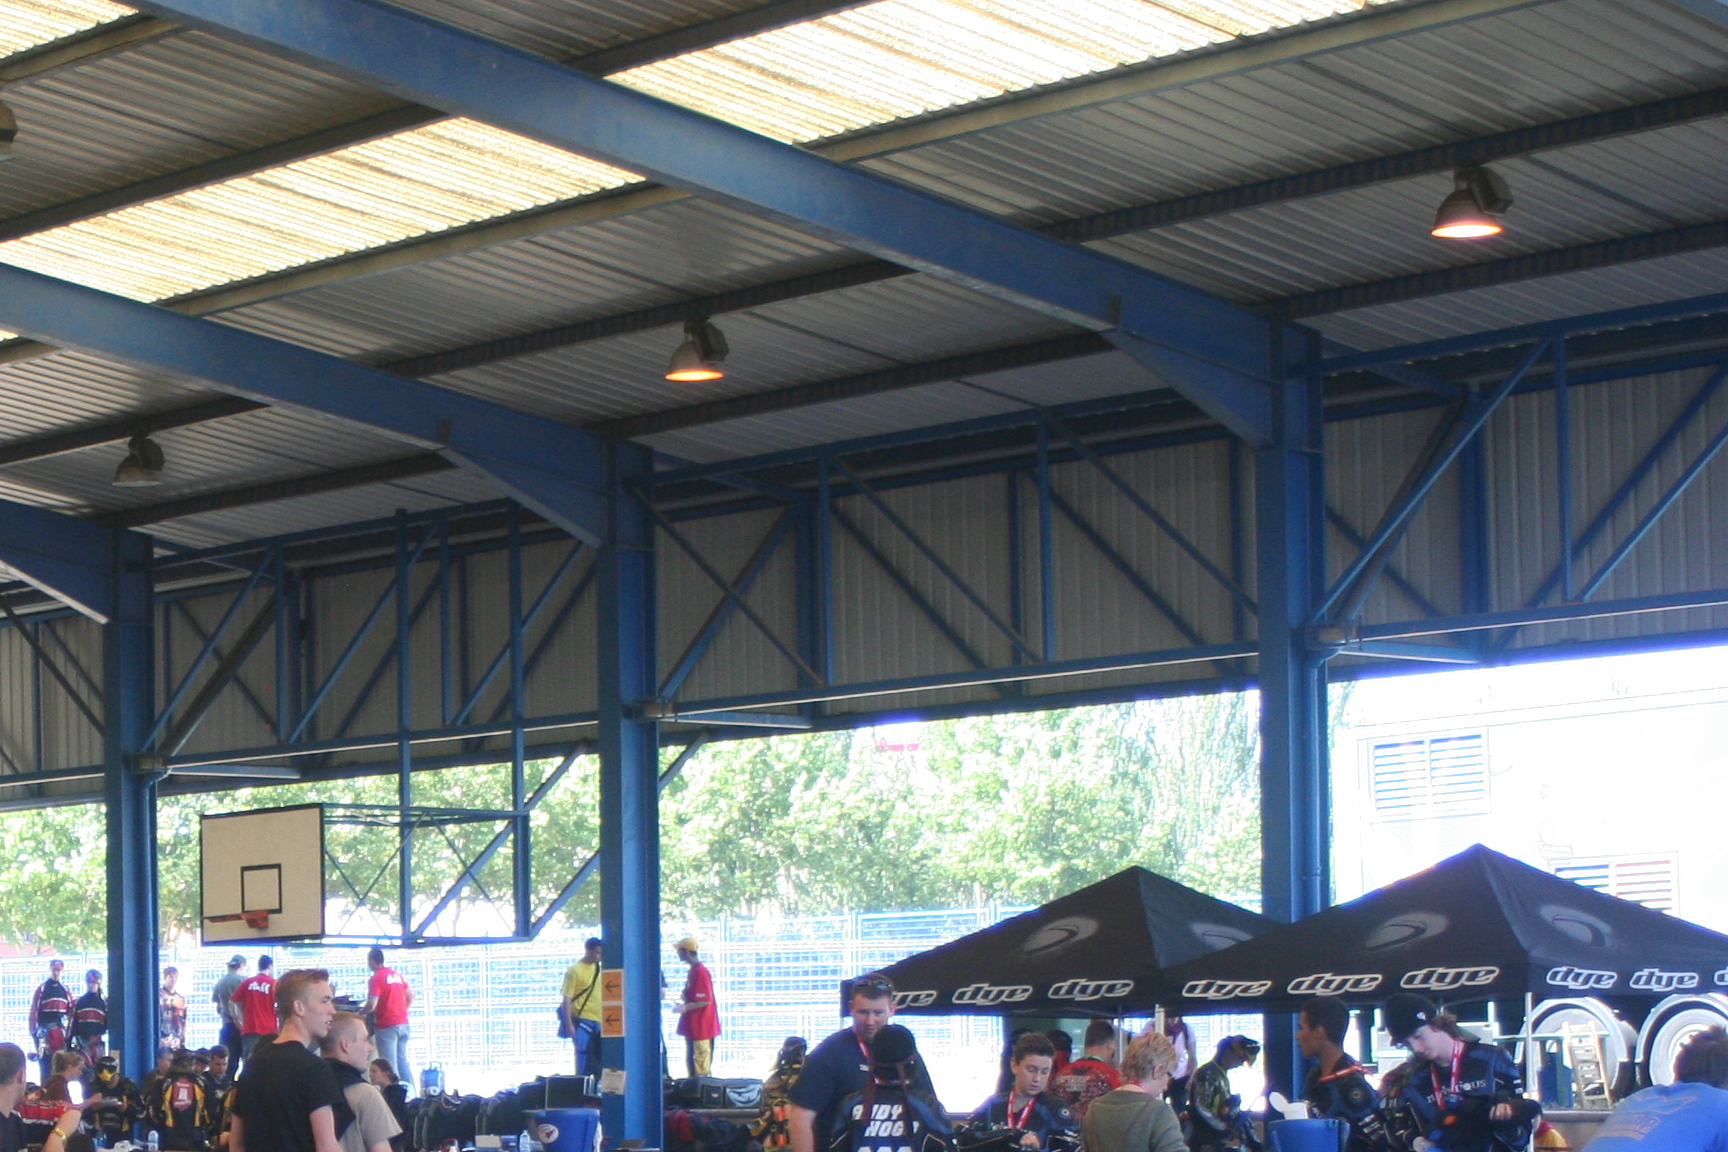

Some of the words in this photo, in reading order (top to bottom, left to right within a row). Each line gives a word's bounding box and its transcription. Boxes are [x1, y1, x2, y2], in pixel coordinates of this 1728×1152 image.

[1048, 978, 1134, 1001] dye
[1182, 979, 1271, 1000] dye
[1287, 972, 1382, 996] dye
[1400, 966, 1499, 990] dye
[1546, 966, 1617, 990] dye
[1630, 968, 1699, 992] dye
[952, 983, 1033, 1006] dye
